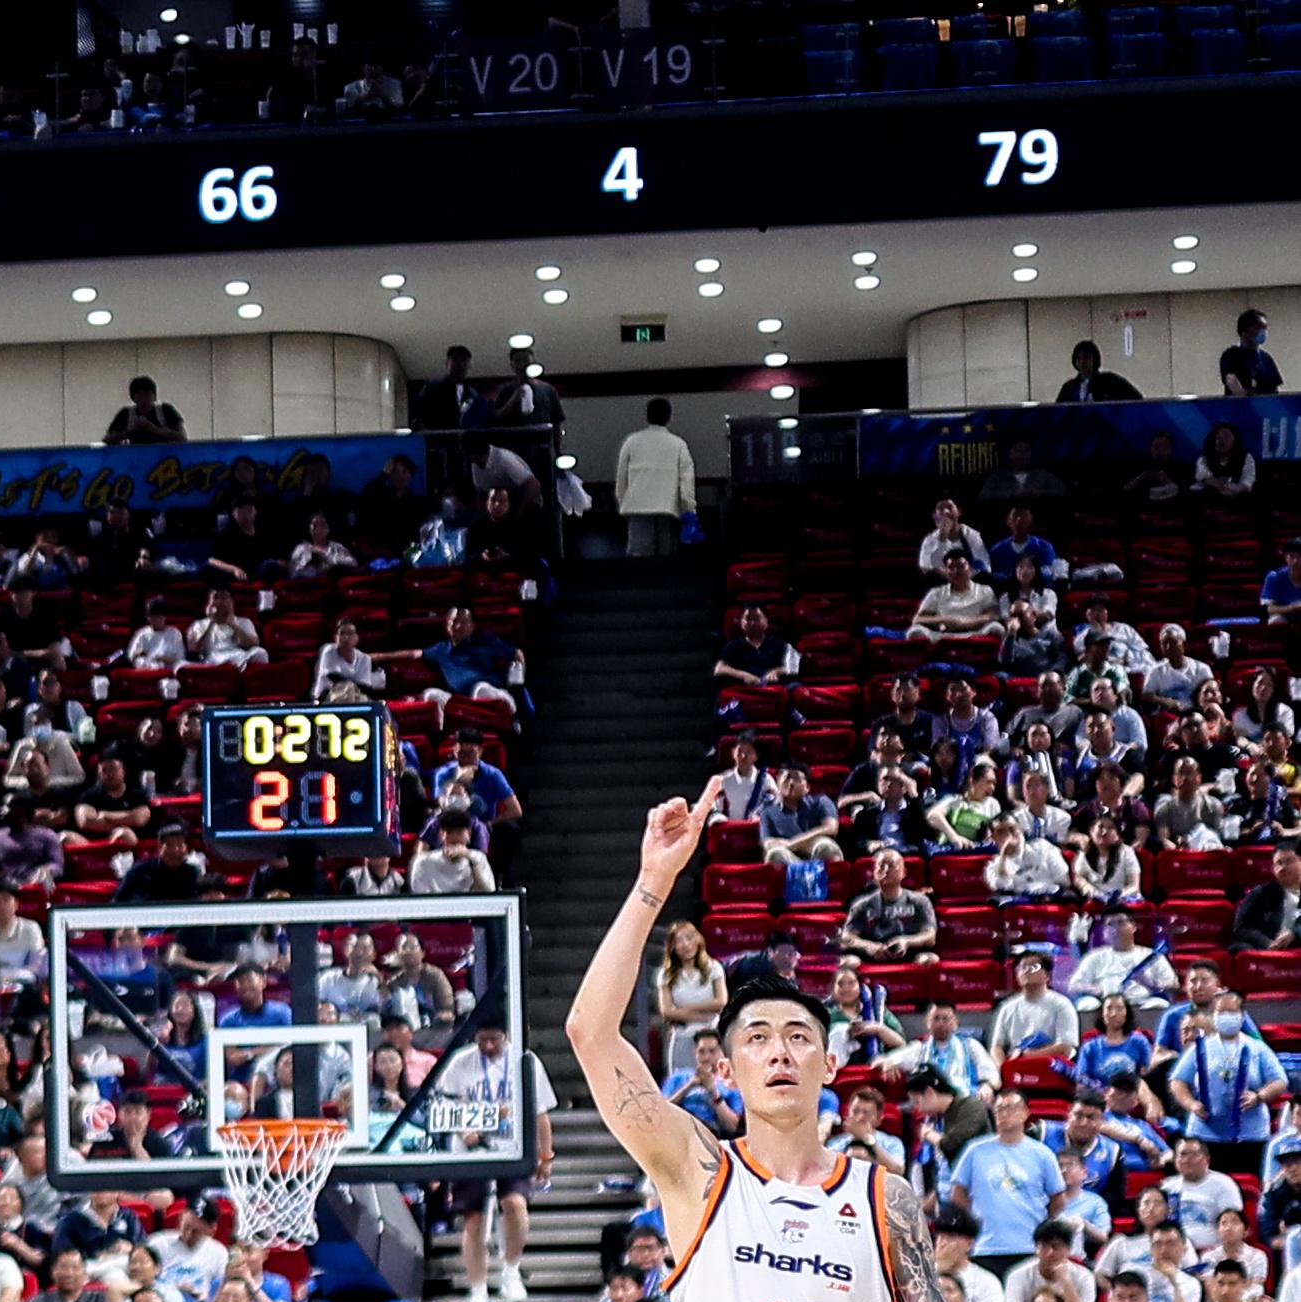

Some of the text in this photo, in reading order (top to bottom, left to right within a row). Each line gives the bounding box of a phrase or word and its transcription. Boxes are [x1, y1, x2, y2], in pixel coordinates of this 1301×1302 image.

[470, 52, 558, 94] V 20
[602, 45, 691, 87] V 19
[198, 165, 278, 223] 66
[602, 146, 644, 200] 4
[978, 128, 1059, 187] 79
[250, 770, 337, 831] 21
[733, 1243, 854, 1283] sharks
